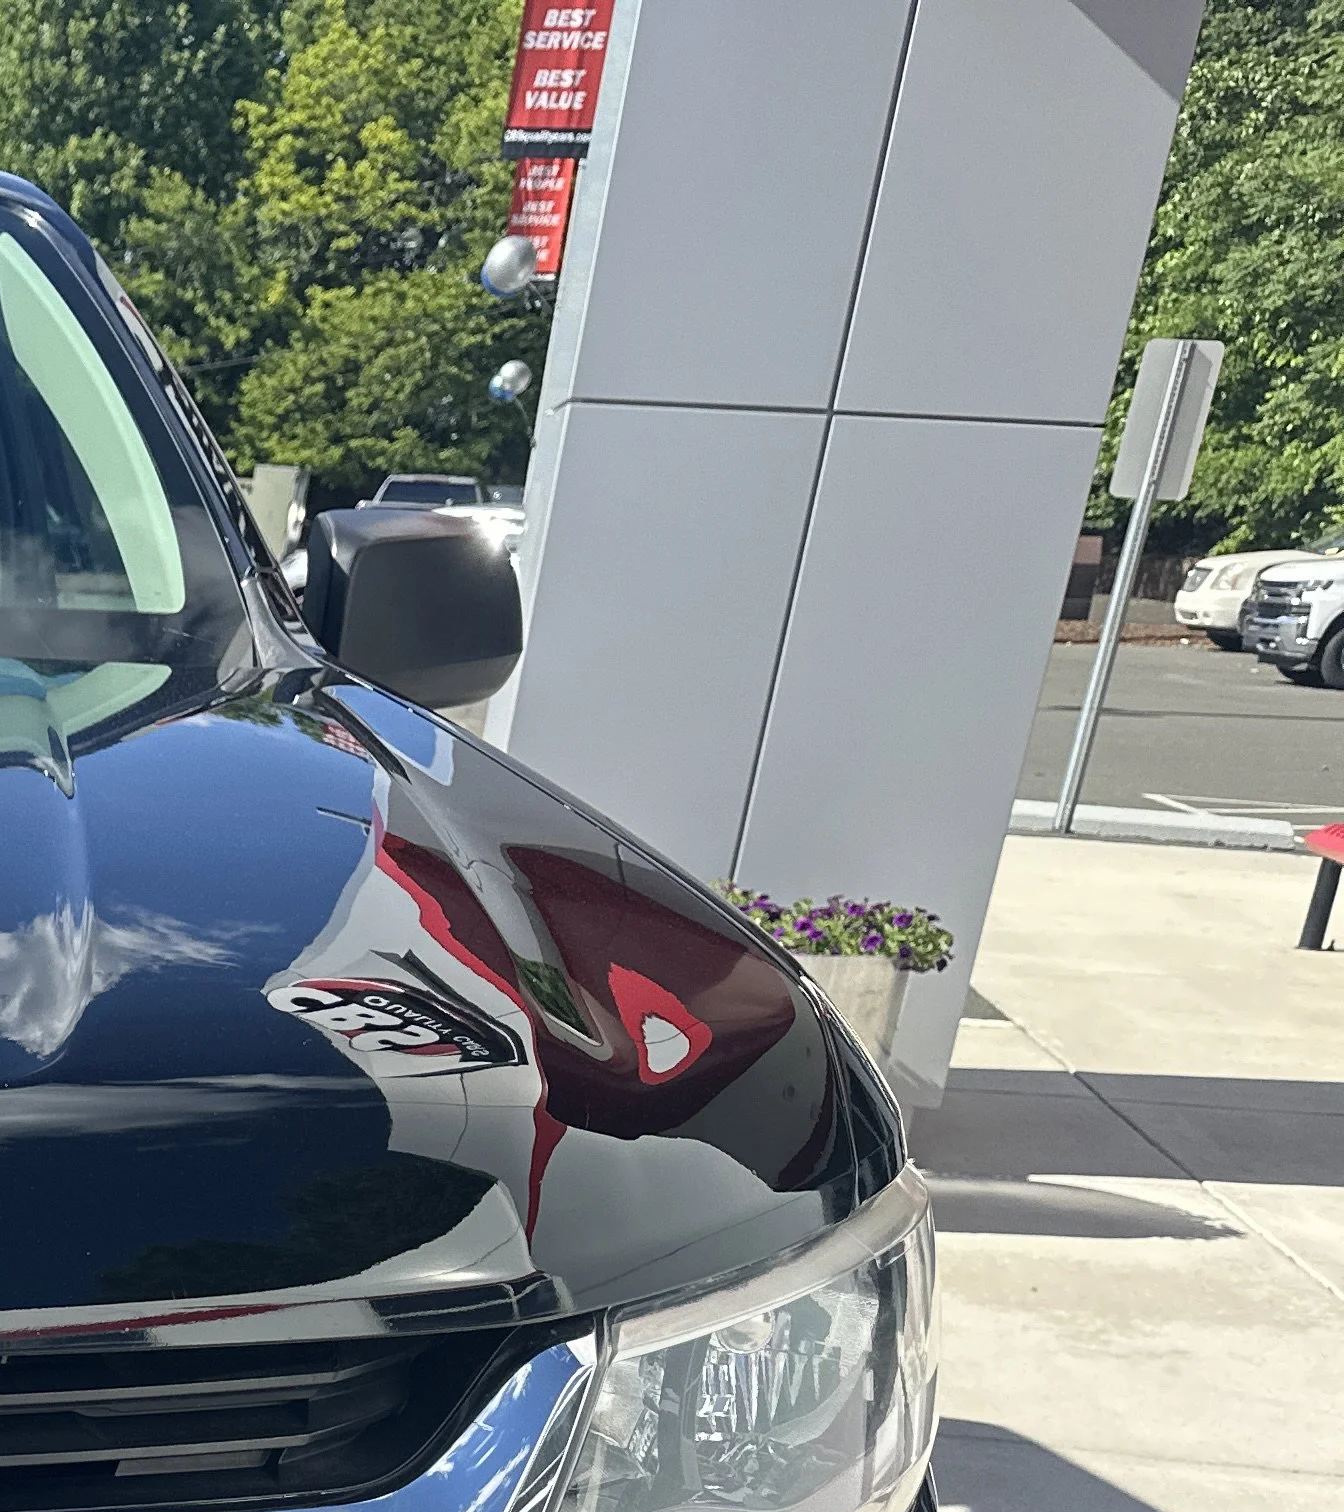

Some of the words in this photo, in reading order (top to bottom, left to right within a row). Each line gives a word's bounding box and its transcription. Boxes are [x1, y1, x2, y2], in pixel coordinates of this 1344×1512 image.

[543, 9, 597, 28] BEST
[523, 31, 608, 50] SERVICE
[533, 69, 587, 87] BEST
[524, 91, 587, 110] VALUE
